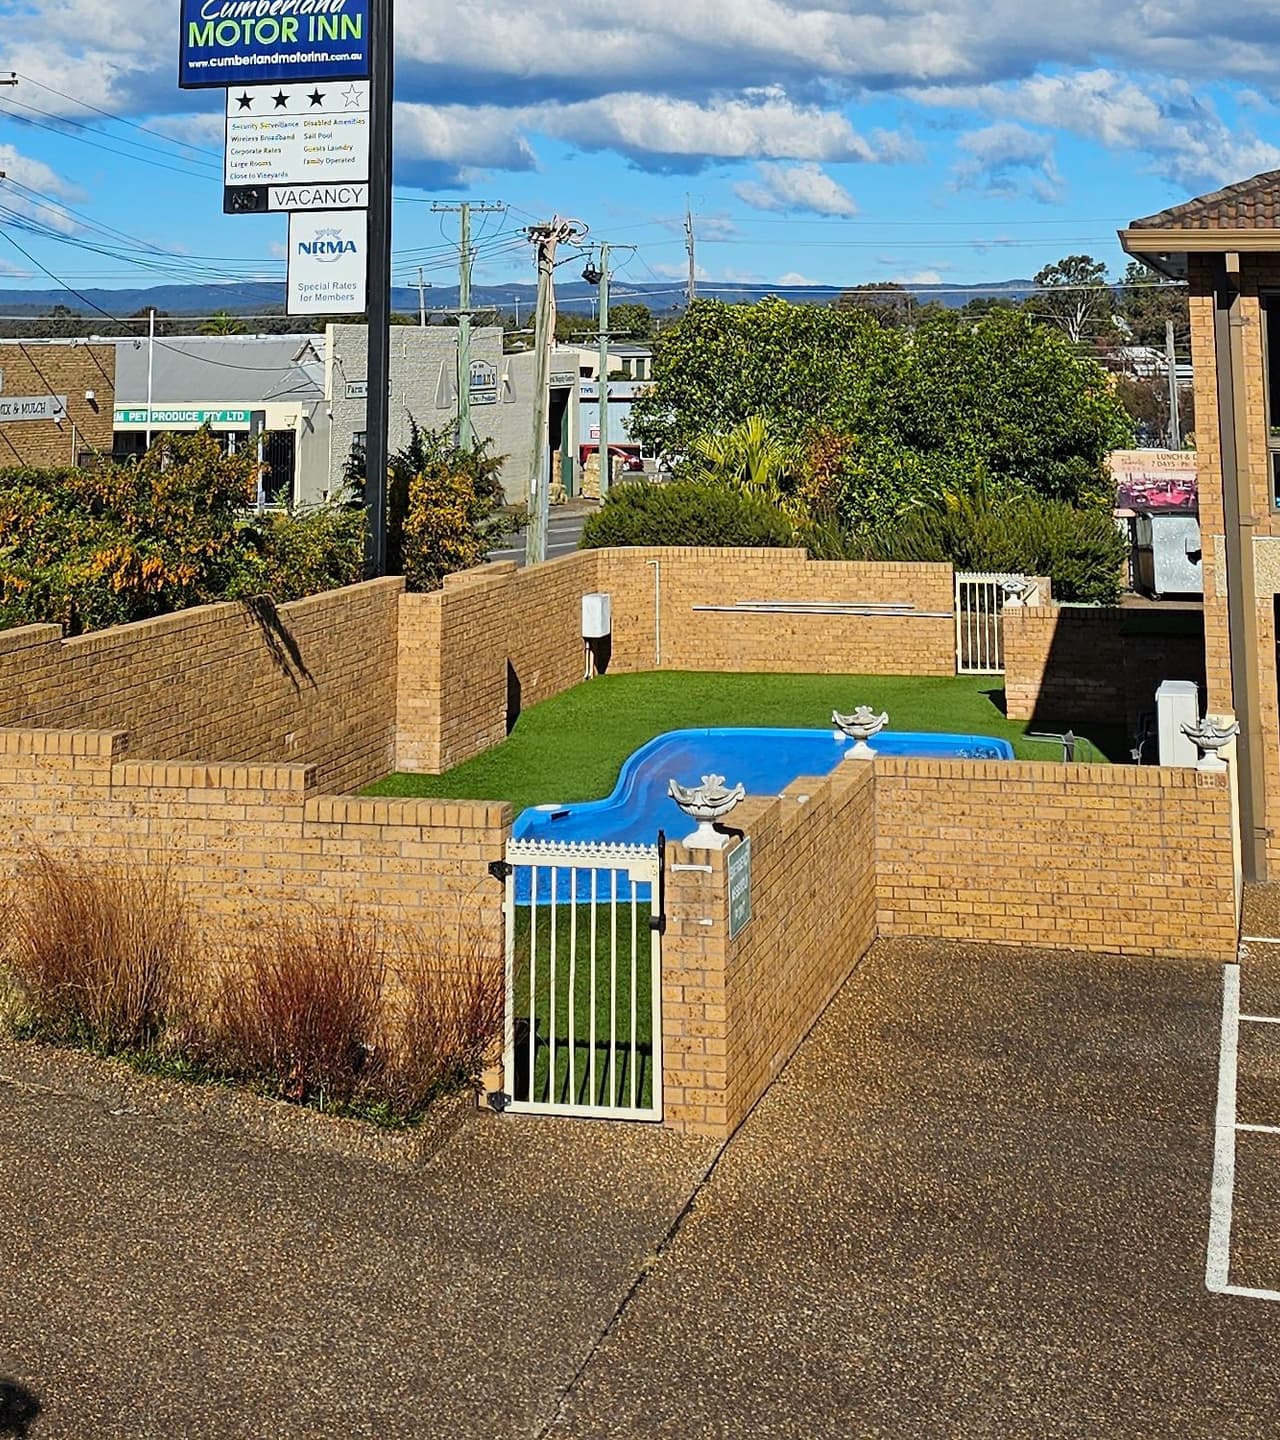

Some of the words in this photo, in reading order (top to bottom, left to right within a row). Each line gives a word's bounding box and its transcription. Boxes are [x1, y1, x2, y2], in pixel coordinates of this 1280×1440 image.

[188, 16, 299, 48] MOTOR
[308, 13, 363, 42] INN
[188, 51, 363, 68] www.cumberlandmotorinn.com.au
[231, 123, 258, 131] Security
[260, 121, 299, 130] Surveillance
[304, 119, 331, 127] Disabled
[333, 118, 366, 126] Amenities
[260, 133, 295, 141] Broadband
[318, 131, 333, 139] Pool
[230, 148, 262, 156] Corporate
[327, 143, 354, 152] Laundry
[230, 161, 248, 169] Large
[303, 158, 324, 166] Family
[325, 156, 356, 165] Operated
[229, 172, 248, 180] Close
[257, 171, 289, 180] Vineyards
[274, 188, 364, 206] VACANCY
[297, 240, 358, 255] NRMA
[297, 282, 330, 292] Special
[332, 281, 357, 290] Rates
[300, 293, 312, 302] for
[314, 293, 355, 302] Members
[347, 384, 363, 394] Farm
[13, 403, 19, 414] &
[21, 402, 46, 414] MULCH
[128, 411, 147, 421] PET
[151, 410, 199, 421] PRODUCE
[203, 410, 222, 421] PTY
[226, 411, 244, 421] LTD
[1156, 453, 1183, 461] LUNCH
